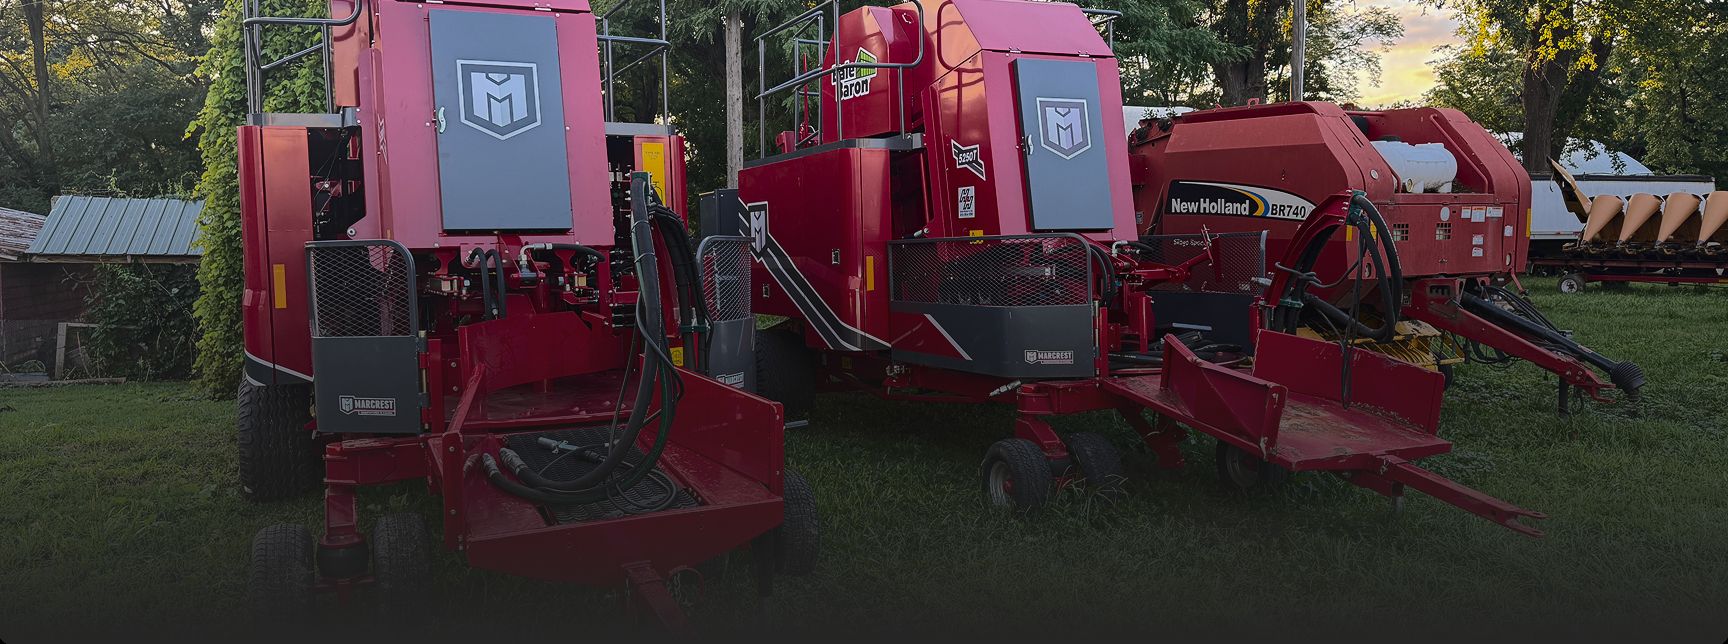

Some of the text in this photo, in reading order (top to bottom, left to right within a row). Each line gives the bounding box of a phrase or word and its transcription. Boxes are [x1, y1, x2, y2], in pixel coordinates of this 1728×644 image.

[958, 149, 977, 163] 5250T
[1171, 198, 1250, 216] New Holland
[1037, 352, 1072, 360] MARCREST
[354, 399, 394, 409] MARCREST
